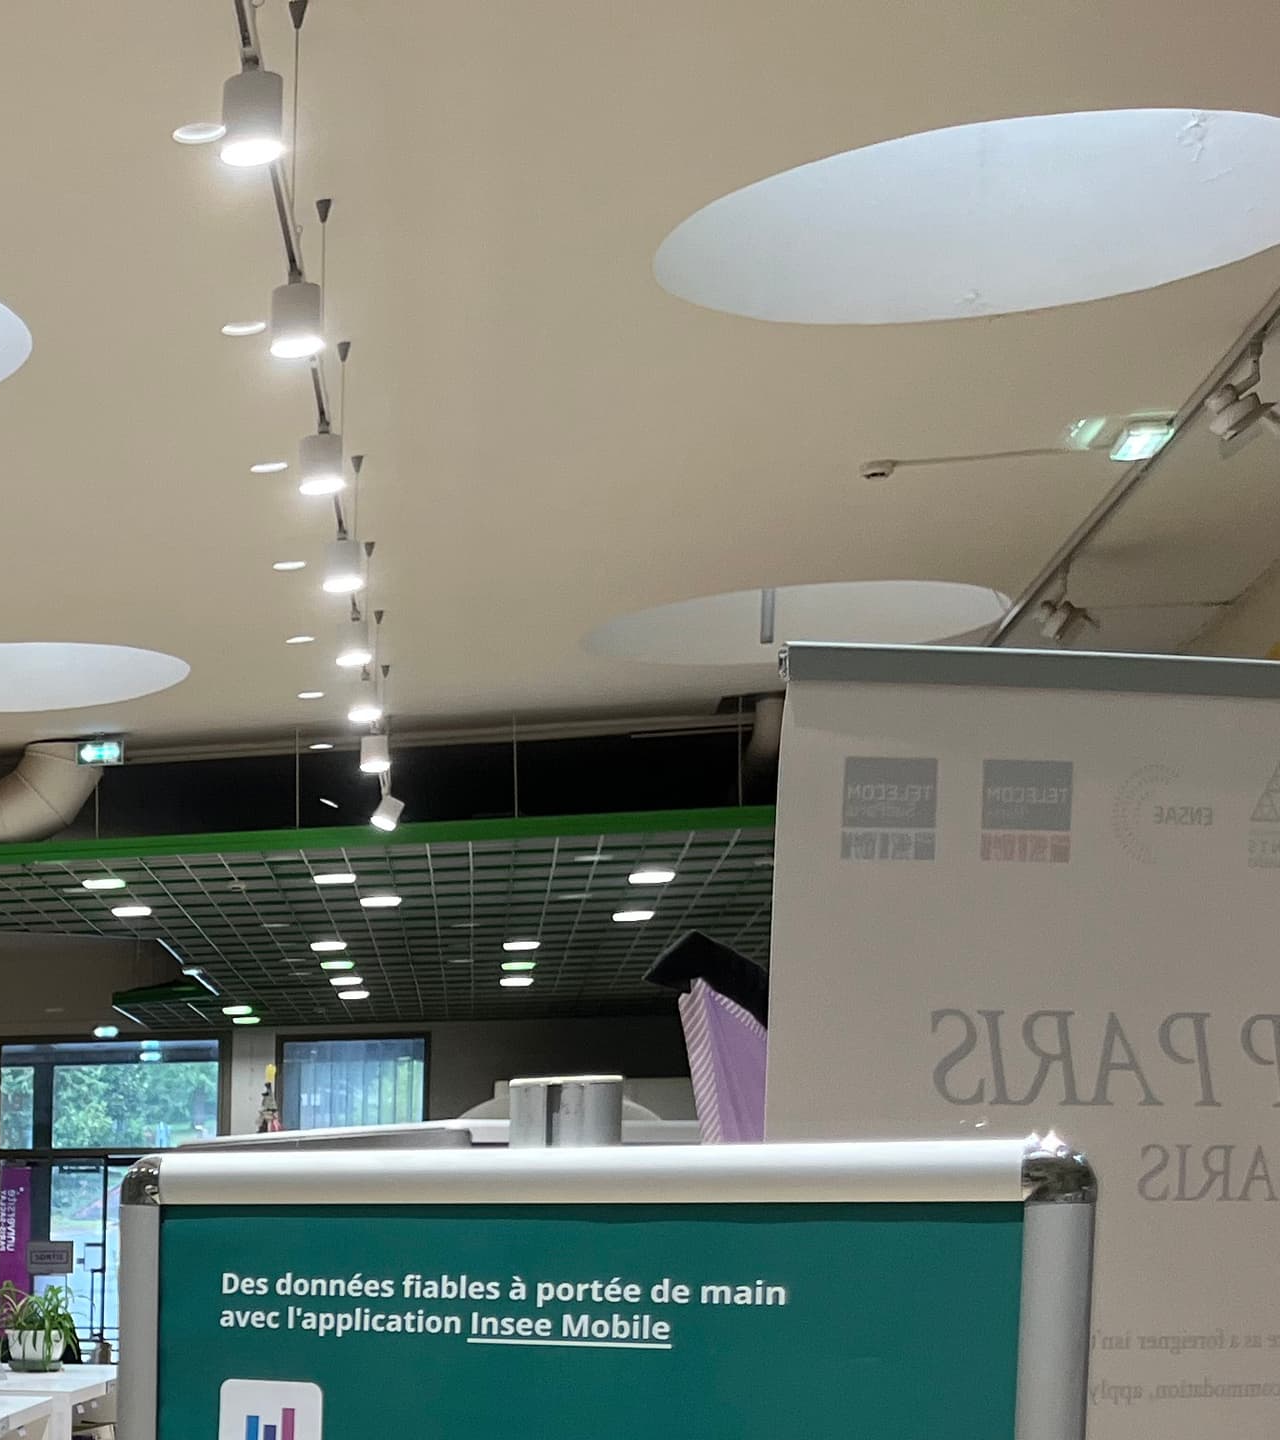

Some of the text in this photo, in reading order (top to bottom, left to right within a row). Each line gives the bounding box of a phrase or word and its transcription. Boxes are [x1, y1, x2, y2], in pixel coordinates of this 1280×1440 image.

[222, 1272, 786, 1307] Des données fiables à portée de main
[220, 1306, 671, 1340] avec l'application Insee Mobile
